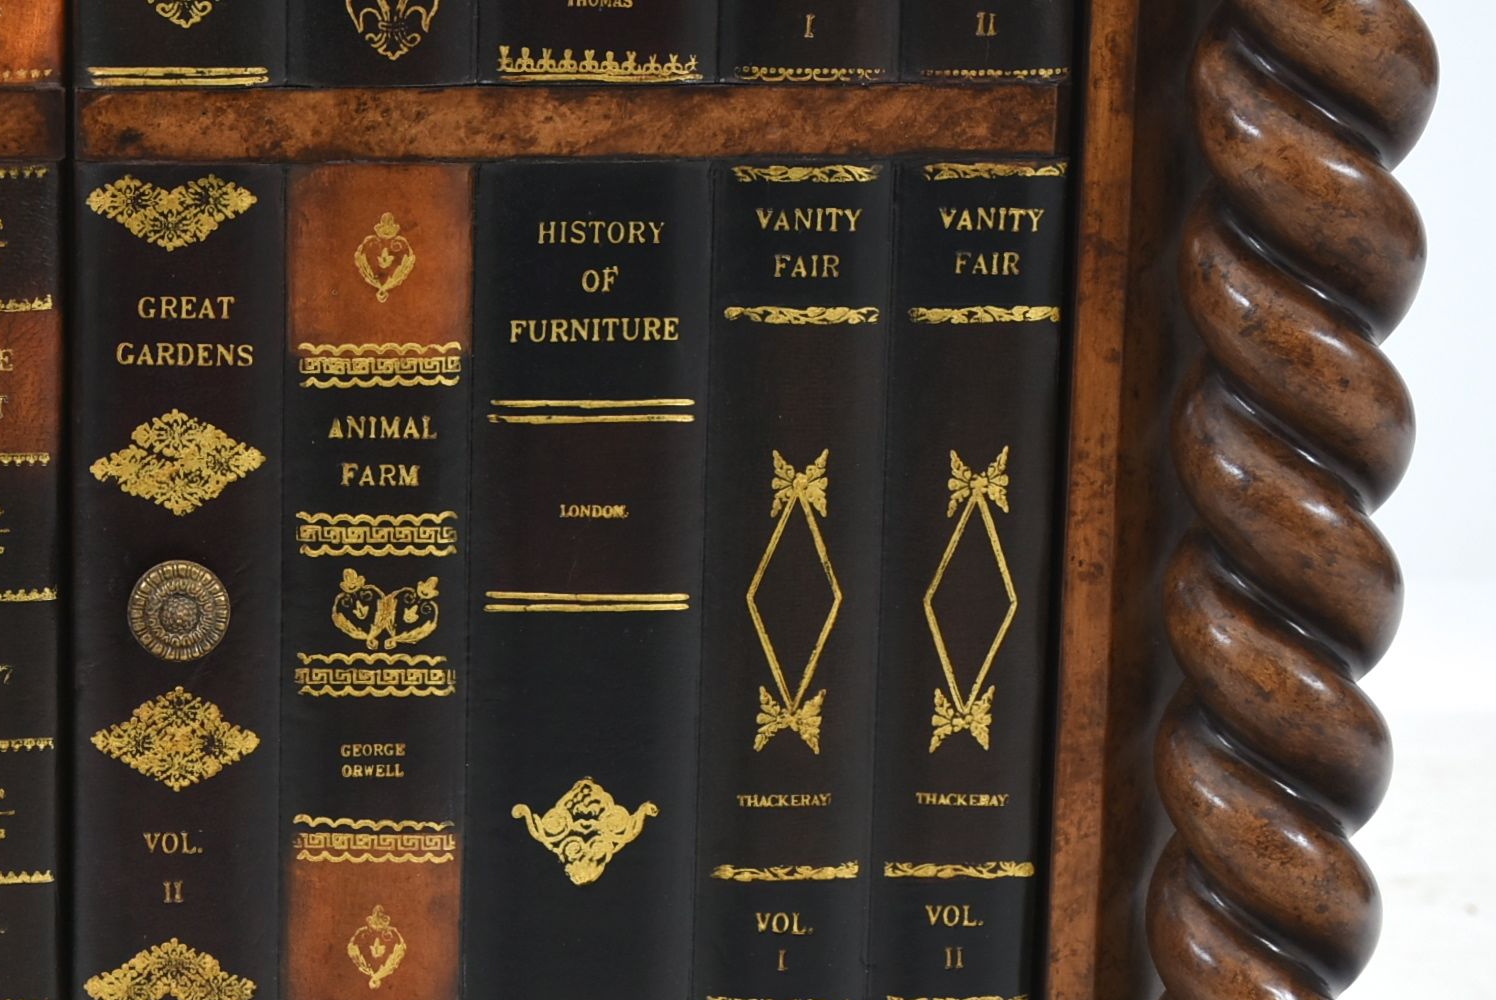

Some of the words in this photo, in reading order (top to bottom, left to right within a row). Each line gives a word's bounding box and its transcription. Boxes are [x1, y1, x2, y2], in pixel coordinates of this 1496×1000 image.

[804, 14, 815, 38] I
[975, 12, 998, 37] II
[755, 207, 862, 232] VANITY
[939, 208, 1044, 232] VANITY
[538, 221, 664, 244] HISTORY
[774, 254, 839, 278] FAIR
[954, 252, 1020, 276] FAIR
[582, 266, 618, 293] OF
[137, 296, 235, 319] GREAT
[509, 316, 679, 344] FURNITURE
[116, 343, 253, 366] GARDENS
[328, 416, 437, 440] ANIMAL
[340, 463, 419, 487] FARM
[340, 743, 406, 757] GEORGE
[341, 763, 404, 778] ORWELL
[737, 793, 828, 808] THACKERAY
[916, 792, 1009, 808] THACKERAY
[143, 832, 203, 854] VOL.
[163, 881, 183, 903] II
[756, 912, 814, 935] VOL.
[925, 904, 984, 927] VOL.
[777, 949, 787, 971] I
[945, 947, 964, 969] II
